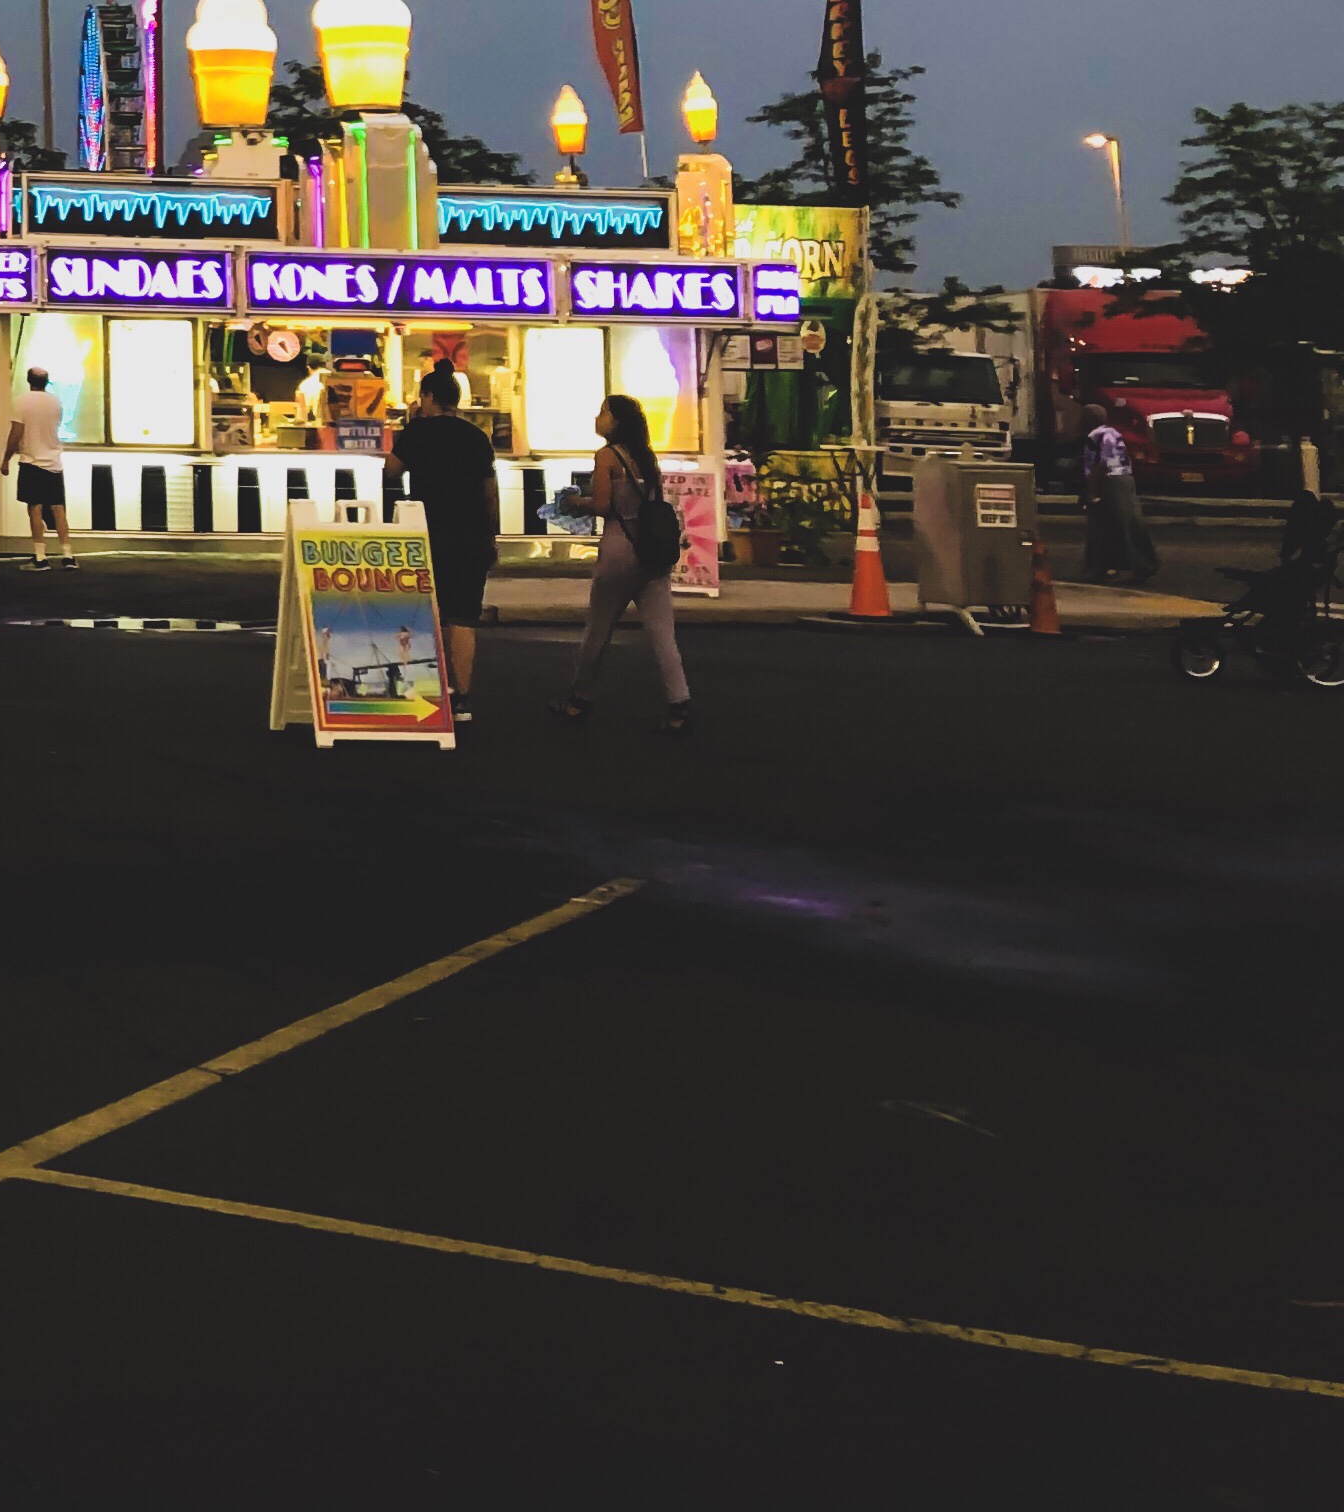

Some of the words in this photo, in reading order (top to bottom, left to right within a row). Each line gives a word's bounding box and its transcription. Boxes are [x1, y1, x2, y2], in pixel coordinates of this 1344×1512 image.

[51, 257, 224, 300] SUNDAES
[765, 236, 846, 283] CORN
[254, 262, 378, 303] KONES
[413, 266, 546, 307] MALTS
[574, 269, 734, 311] SHAKES
[301, 540, 427, 568] BUNGEE
[313, 568, 433, 593] BOUNCE
